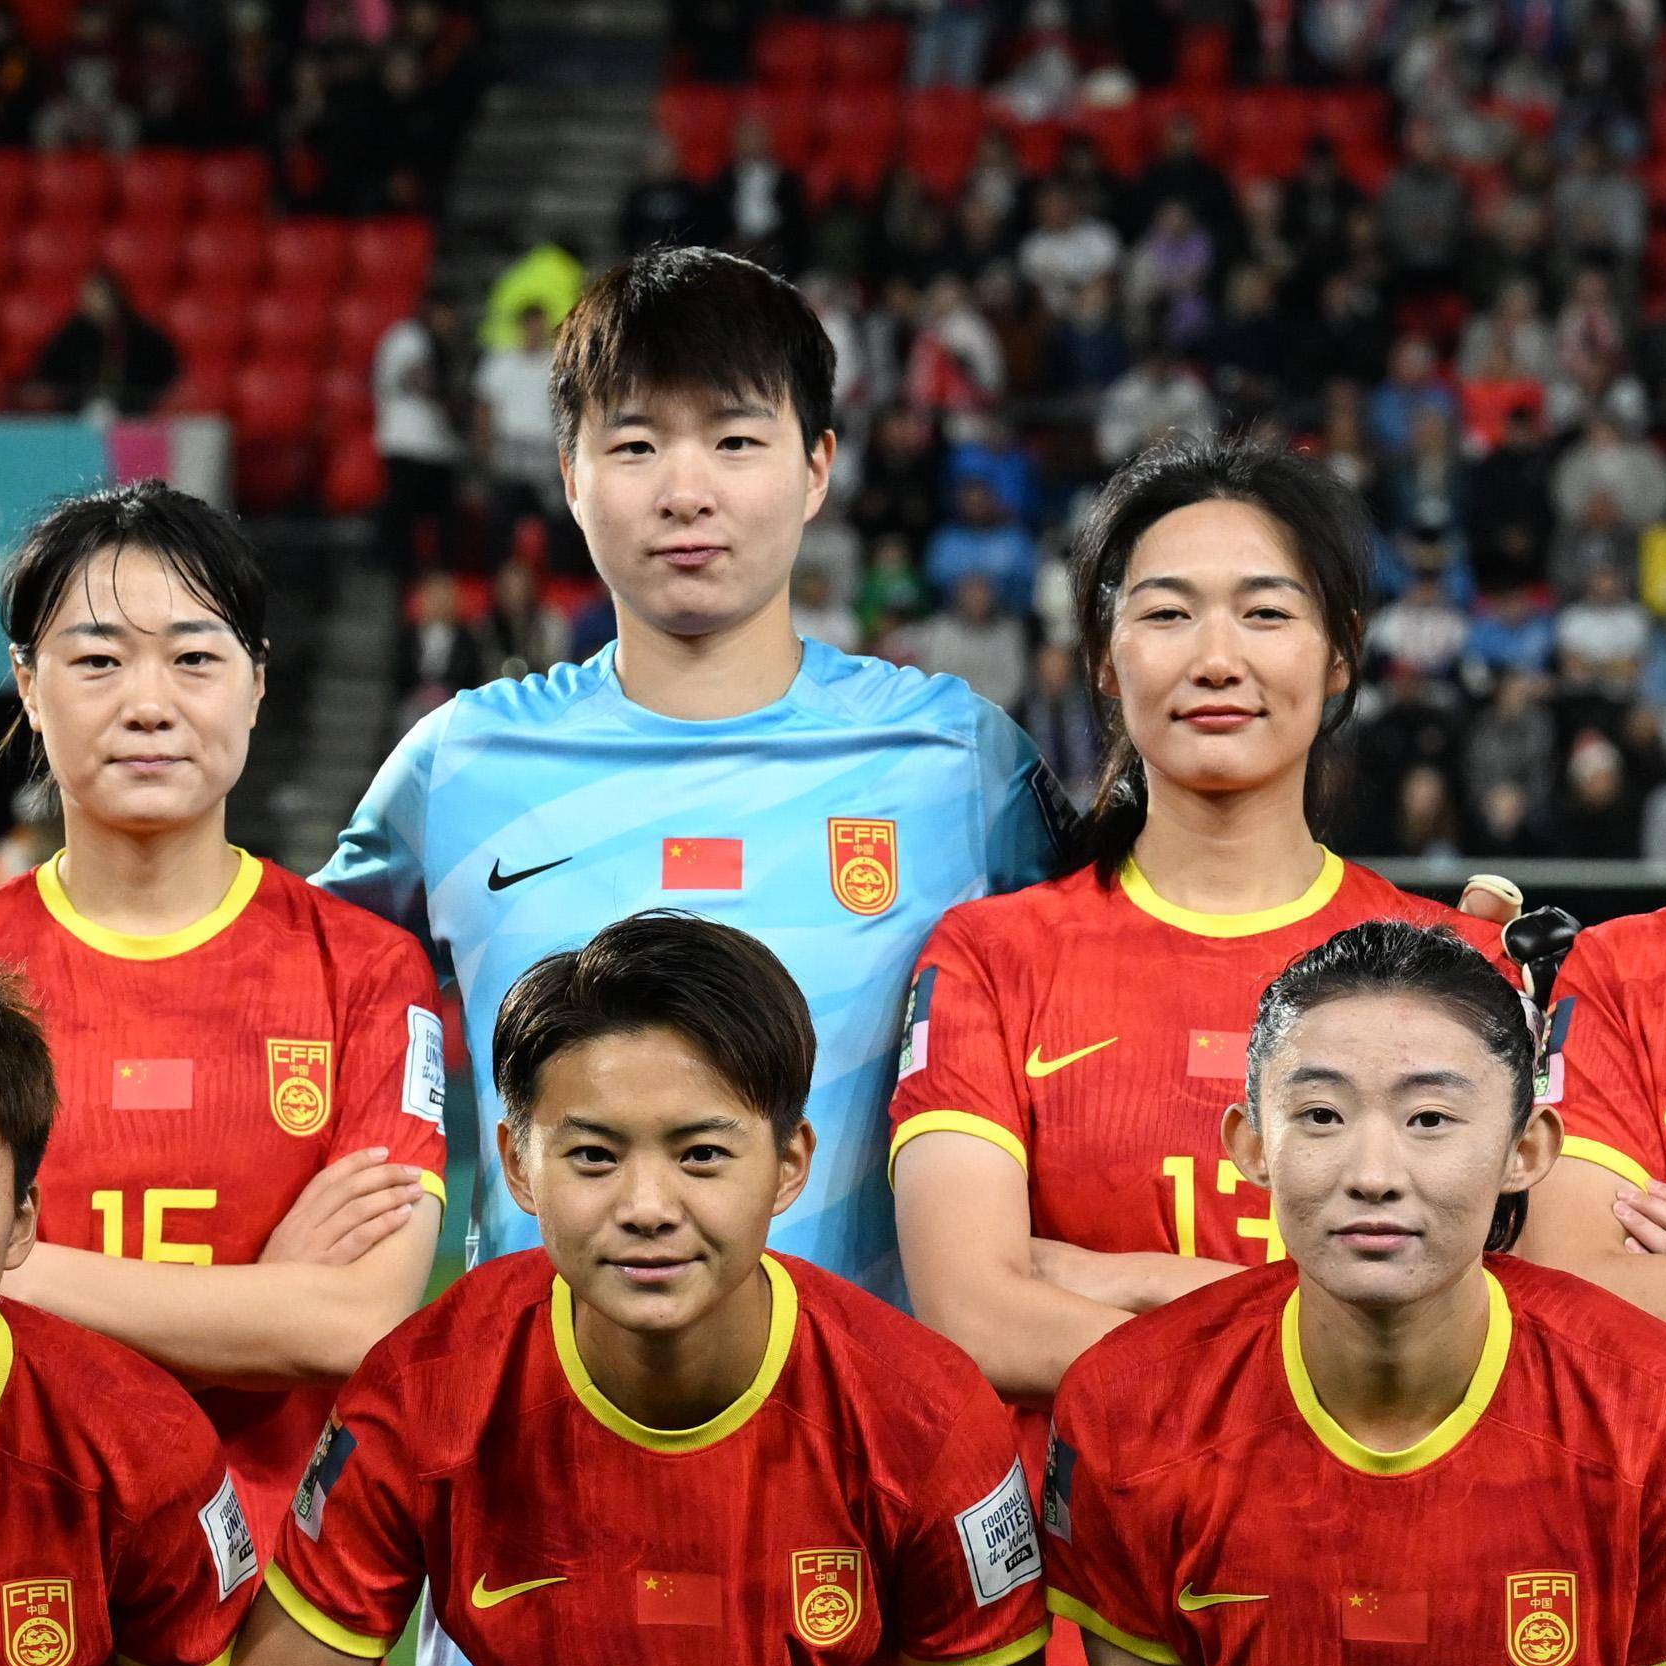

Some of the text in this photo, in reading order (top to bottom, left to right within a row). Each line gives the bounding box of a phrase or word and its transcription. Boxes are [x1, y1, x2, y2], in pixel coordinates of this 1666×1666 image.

[837, 826, 888, 845] CFA
[273, 1045, 324, 1065] CFA
[981, 1487, 1023, 1532] FOOTBALL
[223, 1503, 244, 1540] UNIT
[984, 1500, 1029, 1549] UNITES
[798, 1555, 854, 1574] CFA
[1007, 1549, 1030, 1569] FIFA
[9, 1586, 65, 1607] CFA
[1513, 1579, 1570, 1599] CFA
